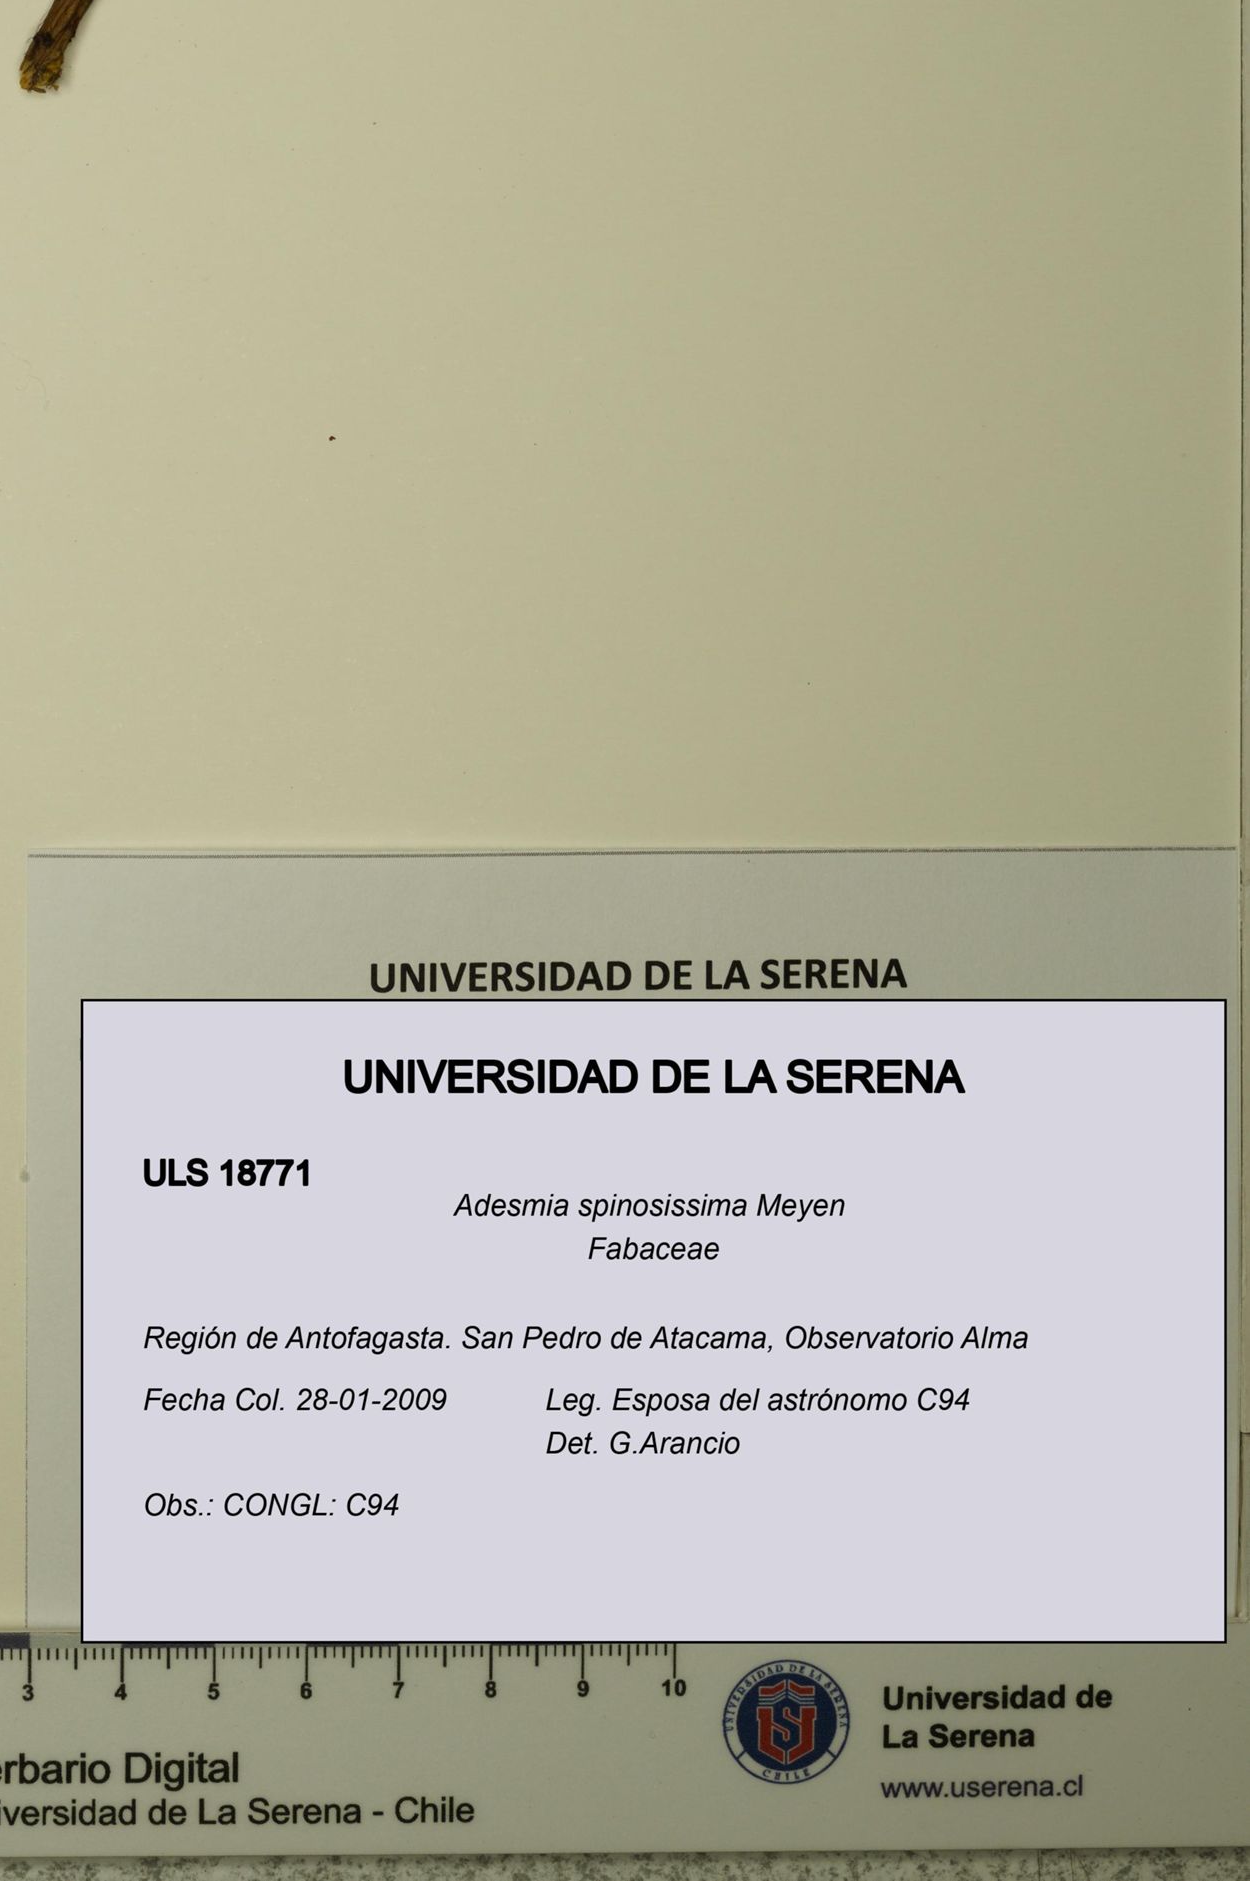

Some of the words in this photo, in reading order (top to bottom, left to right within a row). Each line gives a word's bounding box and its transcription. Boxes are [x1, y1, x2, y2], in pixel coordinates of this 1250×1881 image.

[371, 961, 631, 993] UNIVERSIDAD
[645, 960, 692, 990] DE
[706, 960, 750, 990] LA
[761, 959, 907, 989] SERENA
[22, 1684, 34, 1701] 3
[115, 1683, 127, 1700] 4
[208, 1683, 220, 1700] 5
[300, 1682, 312, 1699] 6
[393, 1682, 405, 1698] 7
[485, 1682, 497, 1698] 8
[577, 1681, 589, 1697] 9
[662, 1680, 687, 1696] 10
[725, 1664, 784, 1732] UNIVERSIDAD
[789, 1664, 806, 1674] DE
[810, 1668, 823, 1680] LA
[824, 1680, 847, 1728] SERENA
[884, 1684, 1065, 1710] Universidad
[1076, 1684, 1112, 1709] de
[883, 1724, 918, 1748] La
[929, 1724, 1034, 1749] Serena
[125, 1752, 238, 1791] Digital
[762, 1768, 810, 1781] CHILE
[881, 1775, 1082, 1798] www.userena.cl
[149, 1799, 186, 1826] de
[199, 1798, 236, 1825] La
[248, 1798, 361, 1825] Serena
[395, 1796, 474, 1823] Chile
